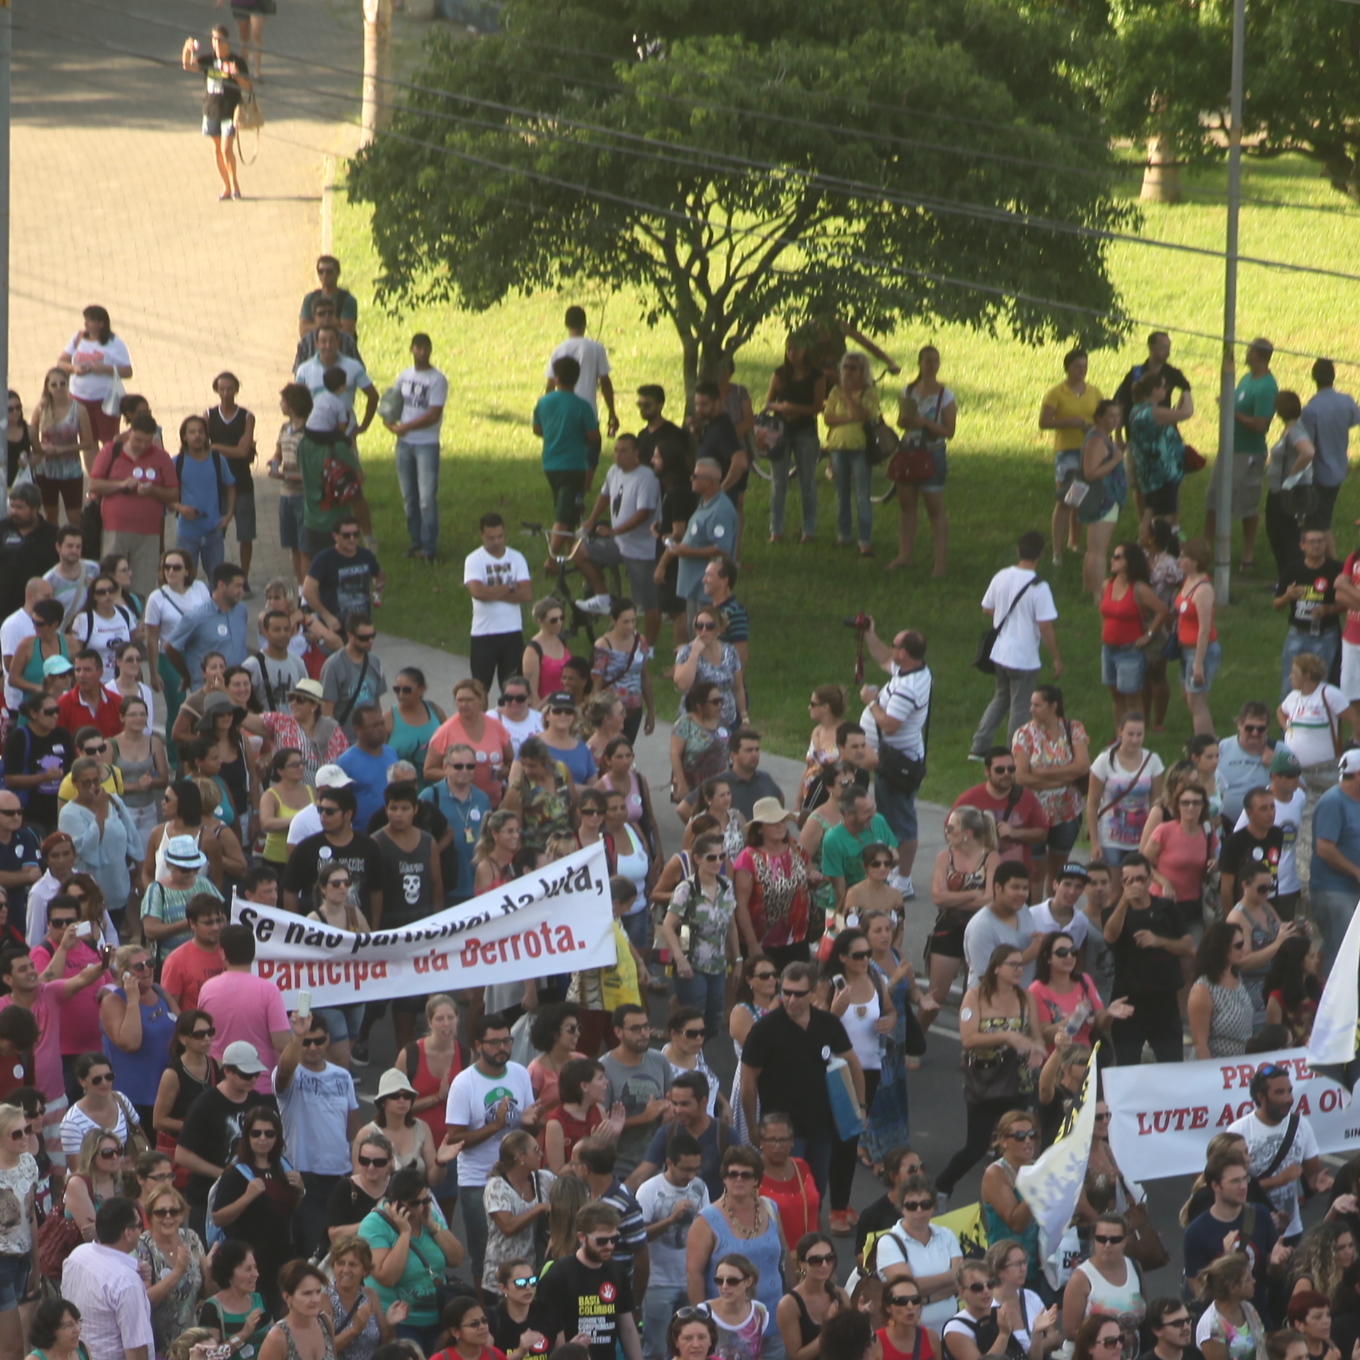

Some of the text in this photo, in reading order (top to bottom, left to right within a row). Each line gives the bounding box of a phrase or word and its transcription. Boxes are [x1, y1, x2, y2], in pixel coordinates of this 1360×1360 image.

[239, 907, 275, 942] Se
[284, 920, 344, 949] não
[459, 921, 586, 968] Derrota.
[1136, 1105, 1210, 1137] LUTE
[1215, 1093, 1312, 1129] AGA
